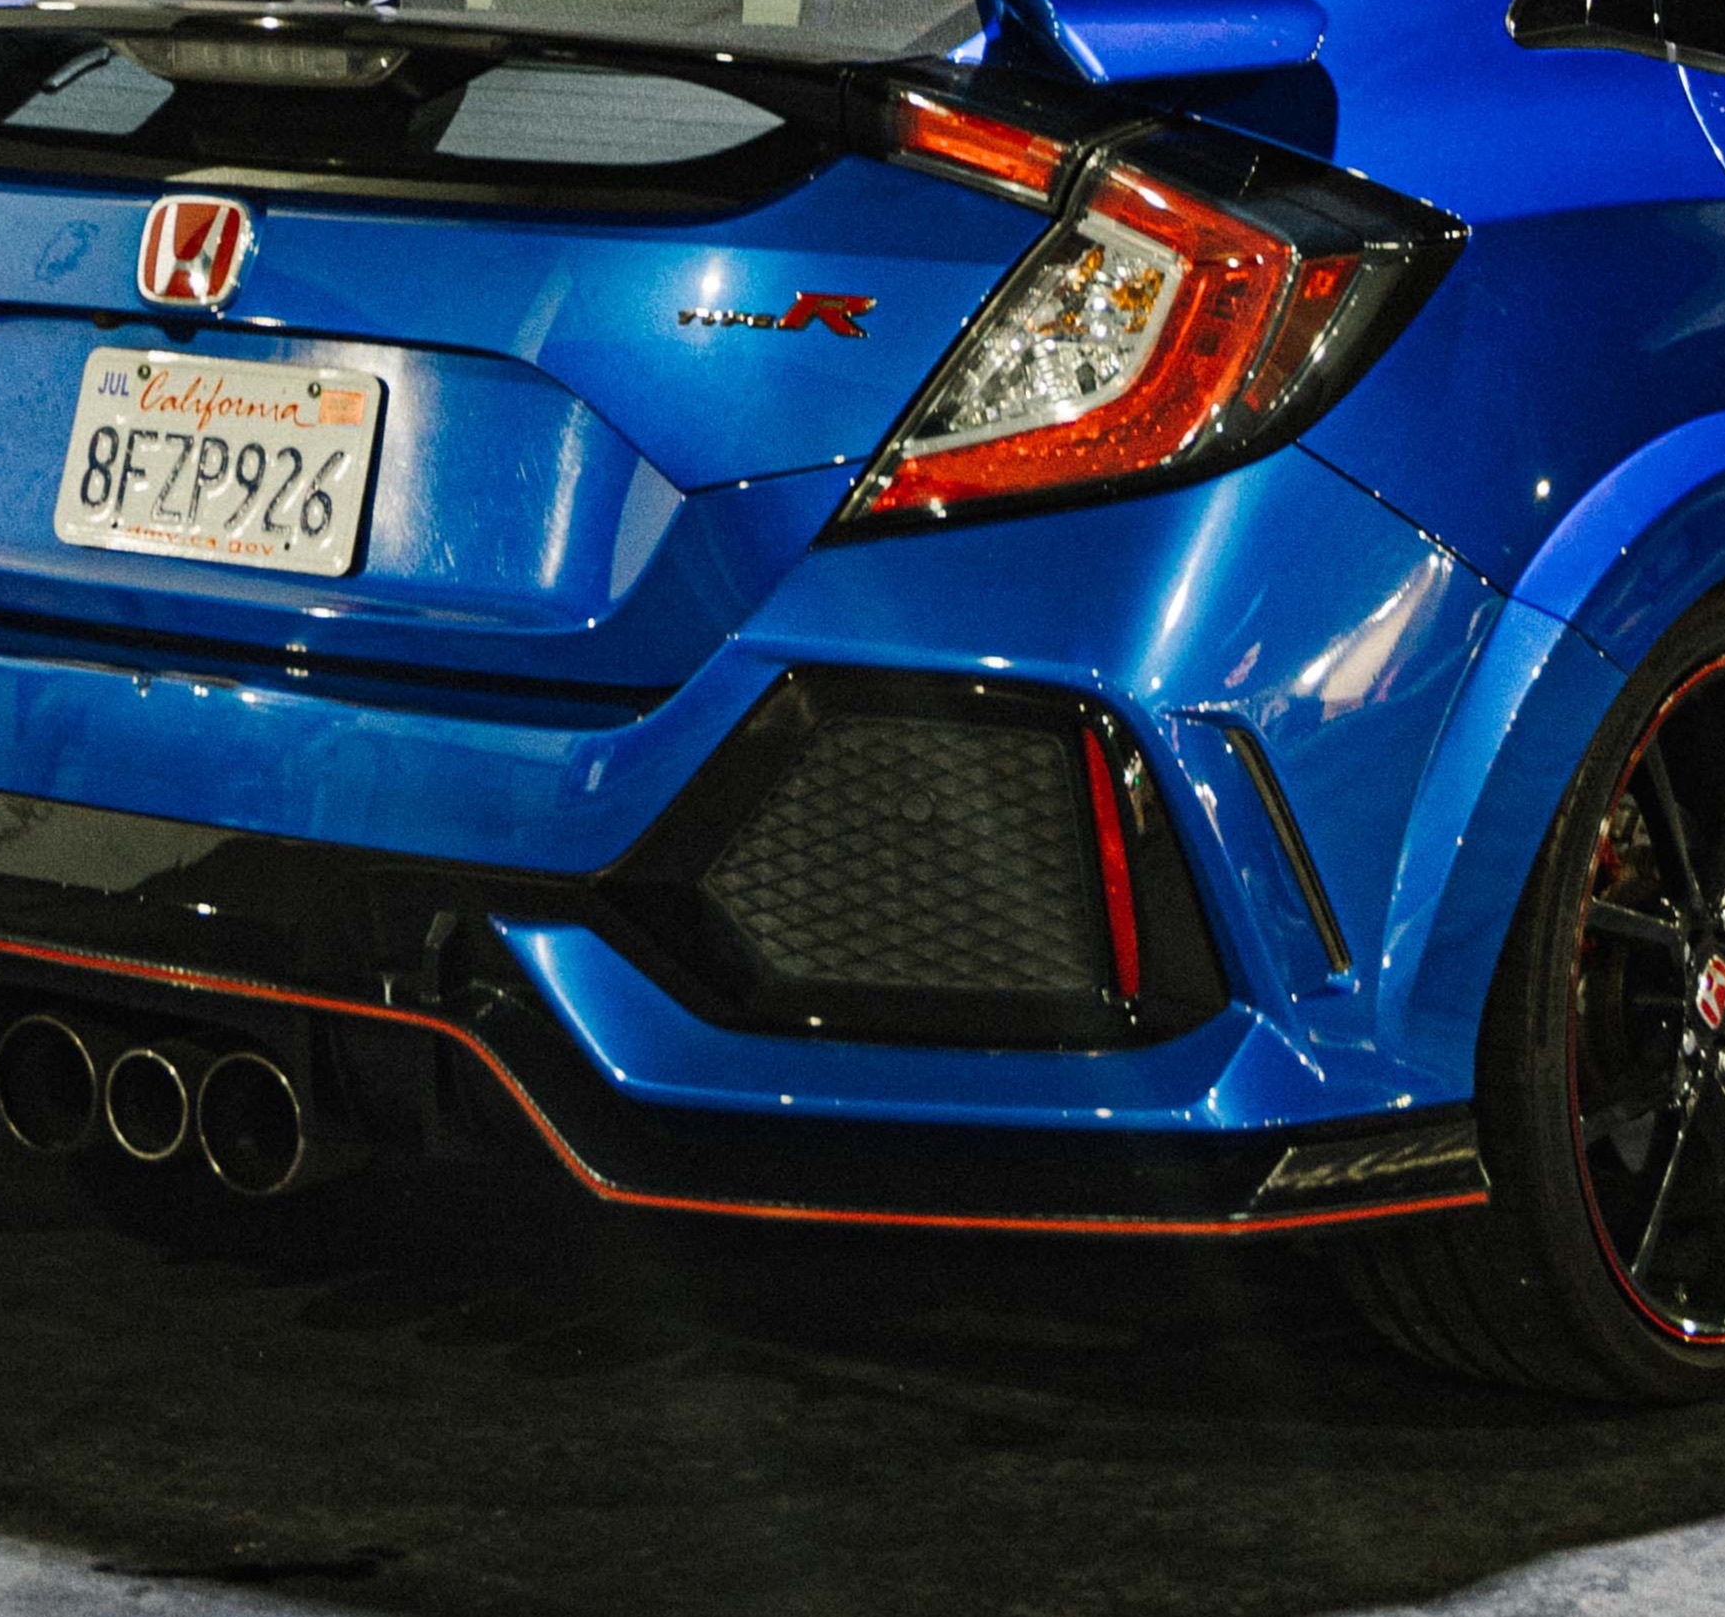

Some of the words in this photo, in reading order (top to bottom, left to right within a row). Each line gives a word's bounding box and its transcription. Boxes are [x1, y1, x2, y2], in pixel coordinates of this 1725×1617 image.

[98, 371, 129, 396] JUL
[139, 370, 317, 431] California
[80, 425, 346, 538] 8FZP926
[127, 524, 276, 557] dmv.ca.gov
